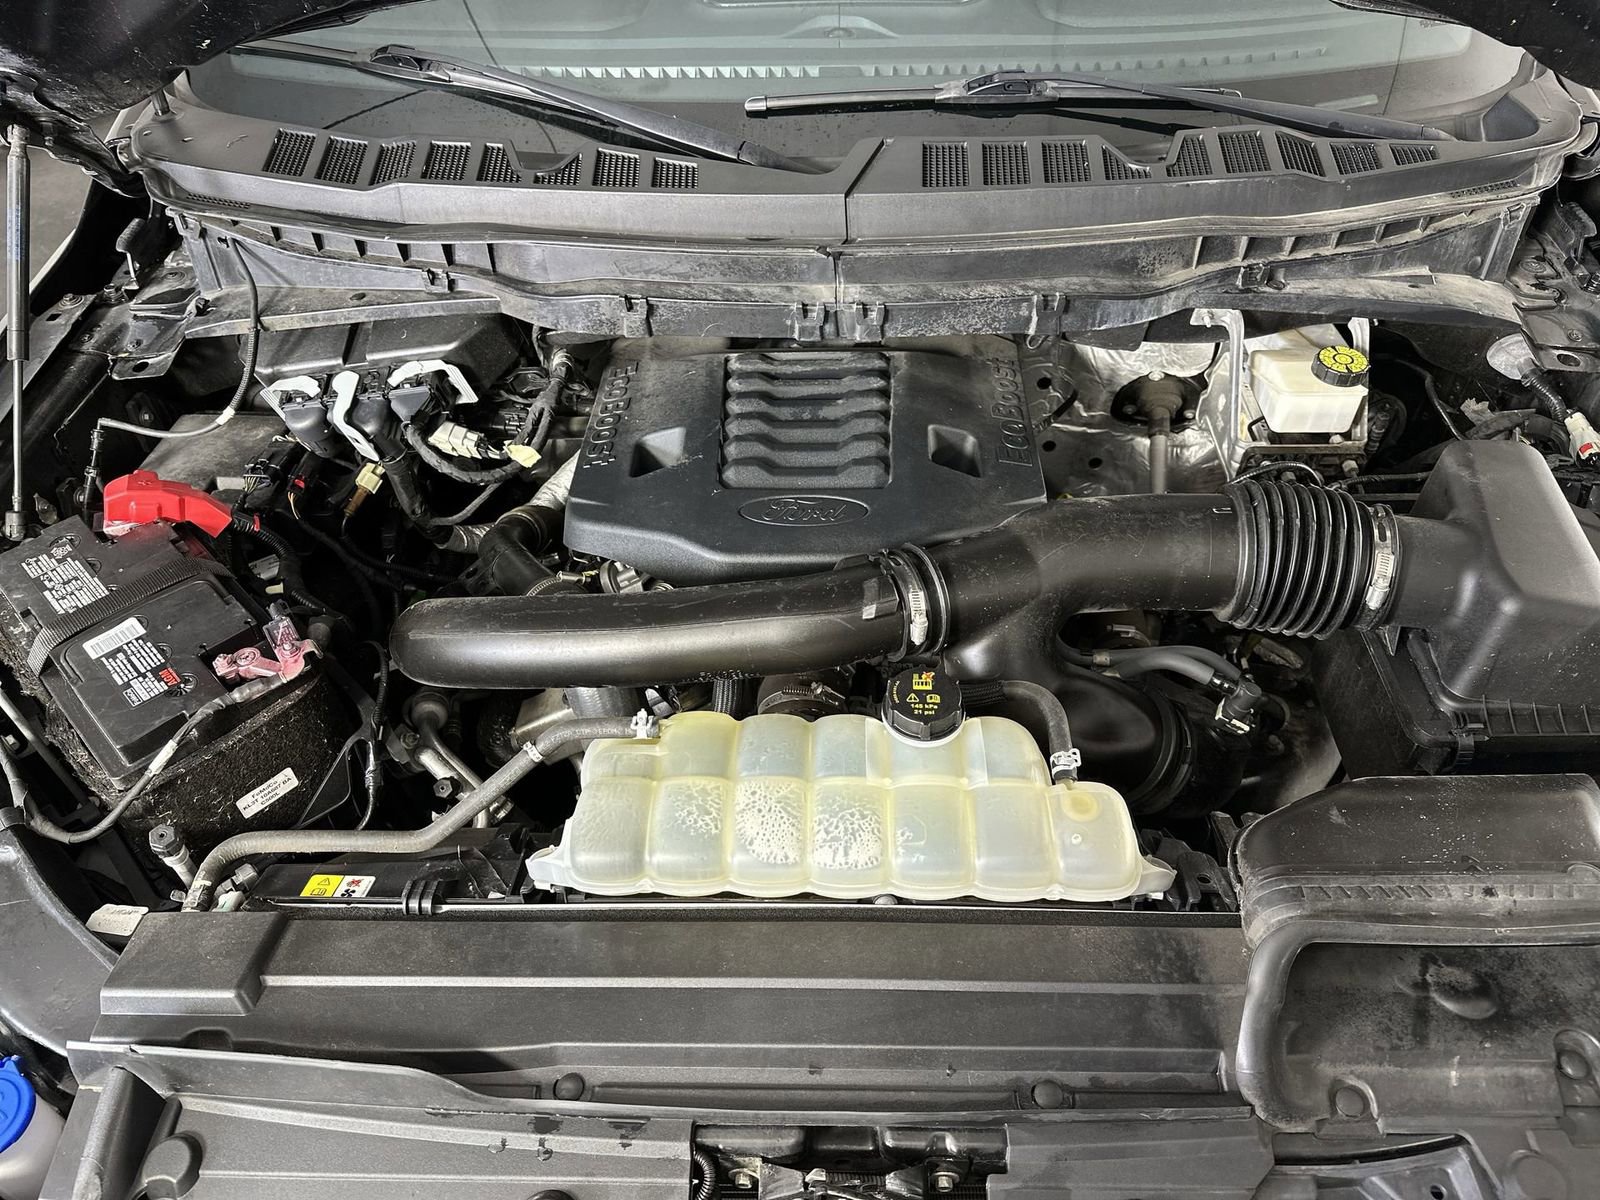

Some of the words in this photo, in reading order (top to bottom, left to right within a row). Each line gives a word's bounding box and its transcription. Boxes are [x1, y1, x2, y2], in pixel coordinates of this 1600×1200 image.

[761, 498, 846, 522] Ford
[159, 668, 178, 687] AGM
[251, 780, 278, 799] FoMoCo
